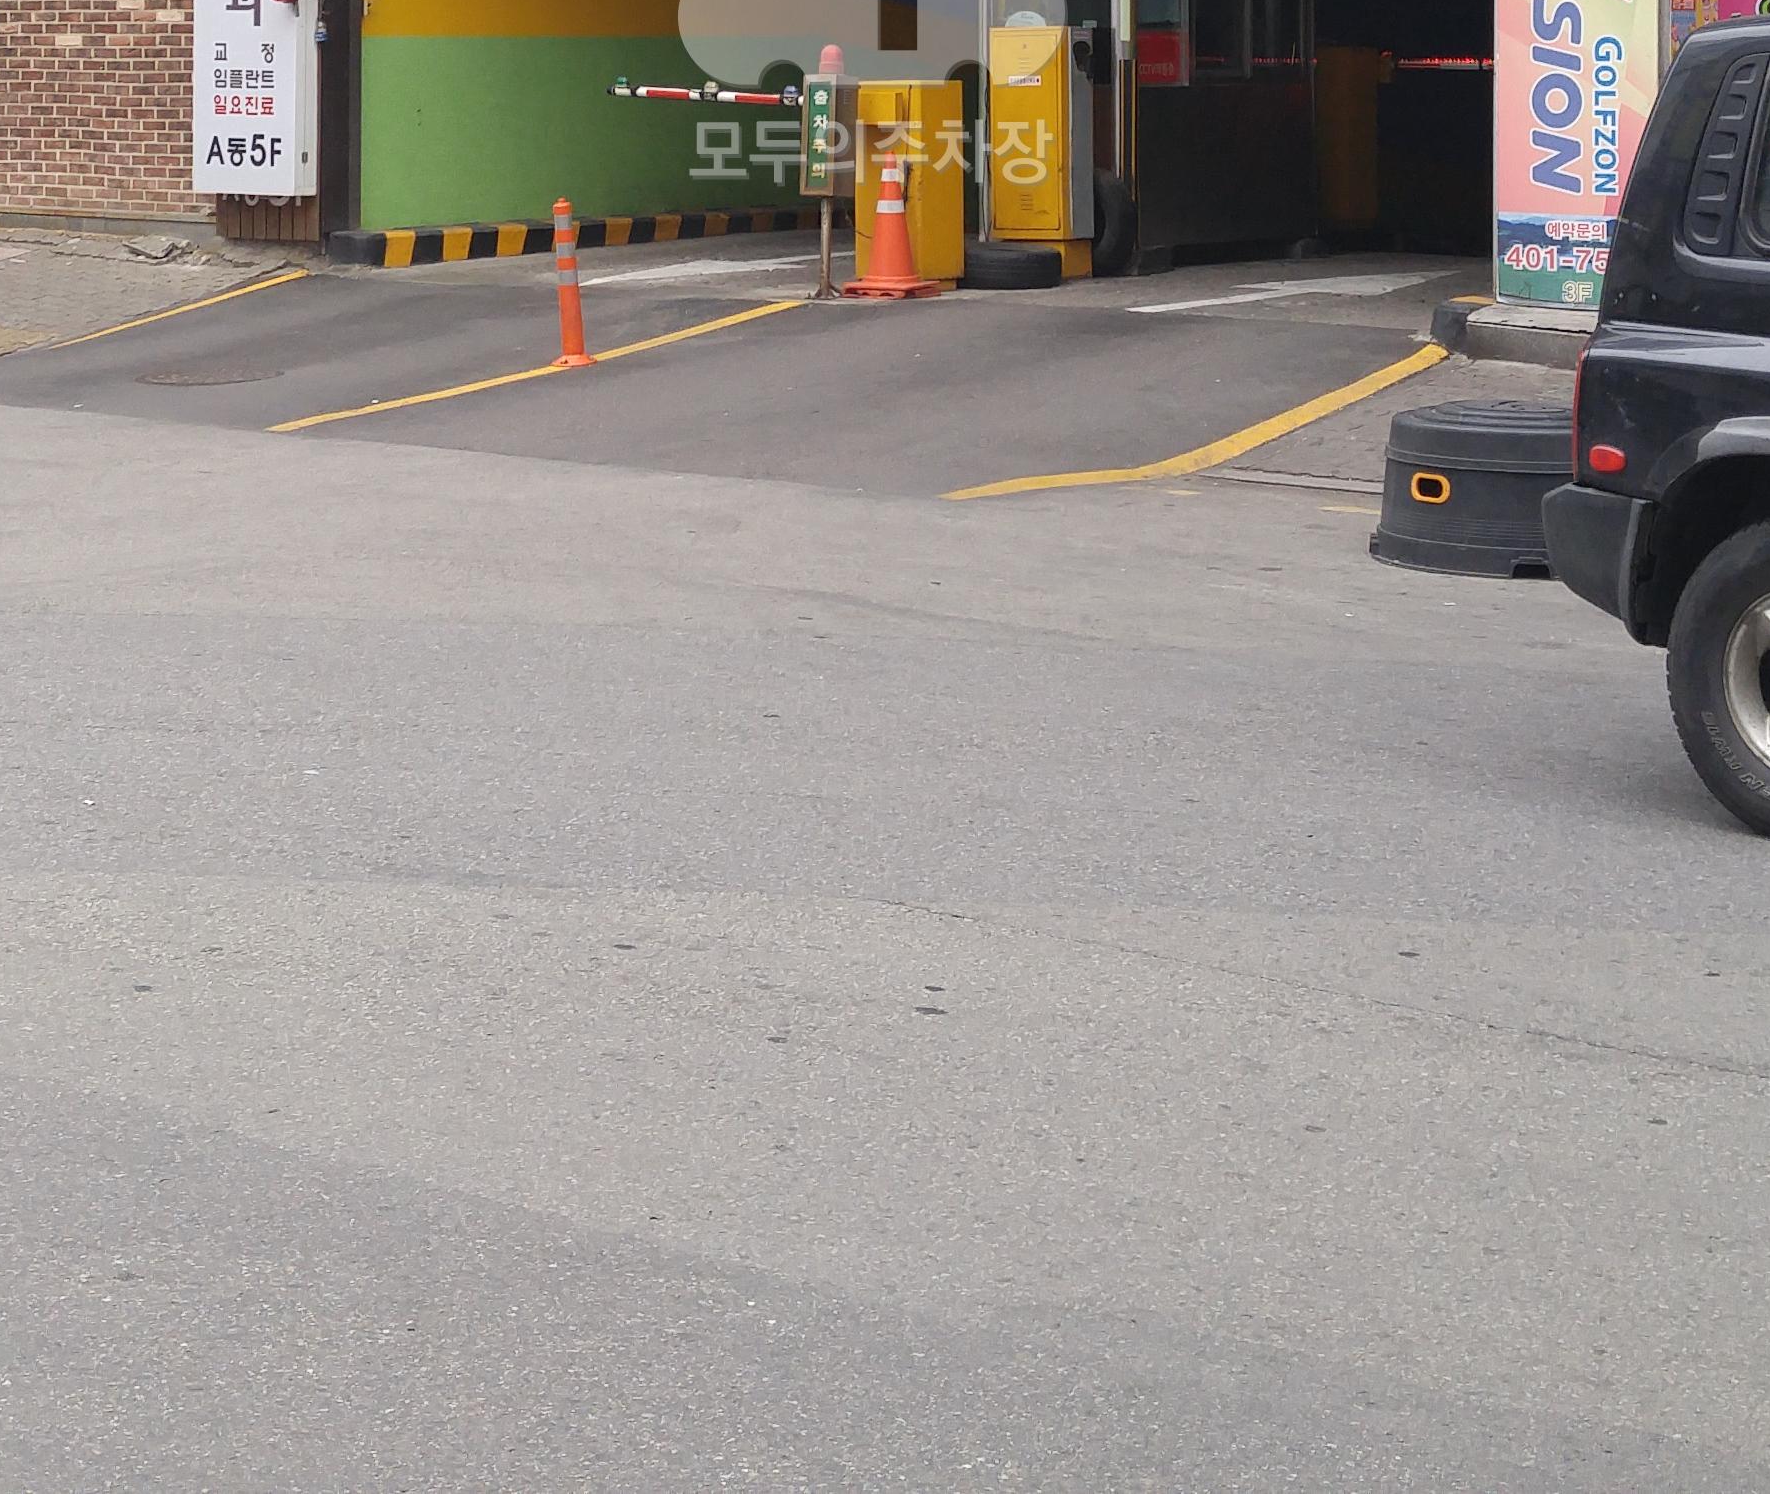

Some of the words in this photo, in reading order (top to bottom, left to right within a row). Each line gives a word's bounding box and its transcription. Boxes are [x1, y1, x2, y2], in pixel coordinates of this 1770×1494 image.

[214, 68, 275, 90] 임플란트
[213, 94, 275, 117] 일요진료
[1592, 36, 1625, 195] GOLFZON
[812, 89, 831, 181] 출차주의
[206, 134, 283, 169] A동5F
[1547, 222, 1606, 242] 예약문의
[1562, 281, 1592, 303] 3F
